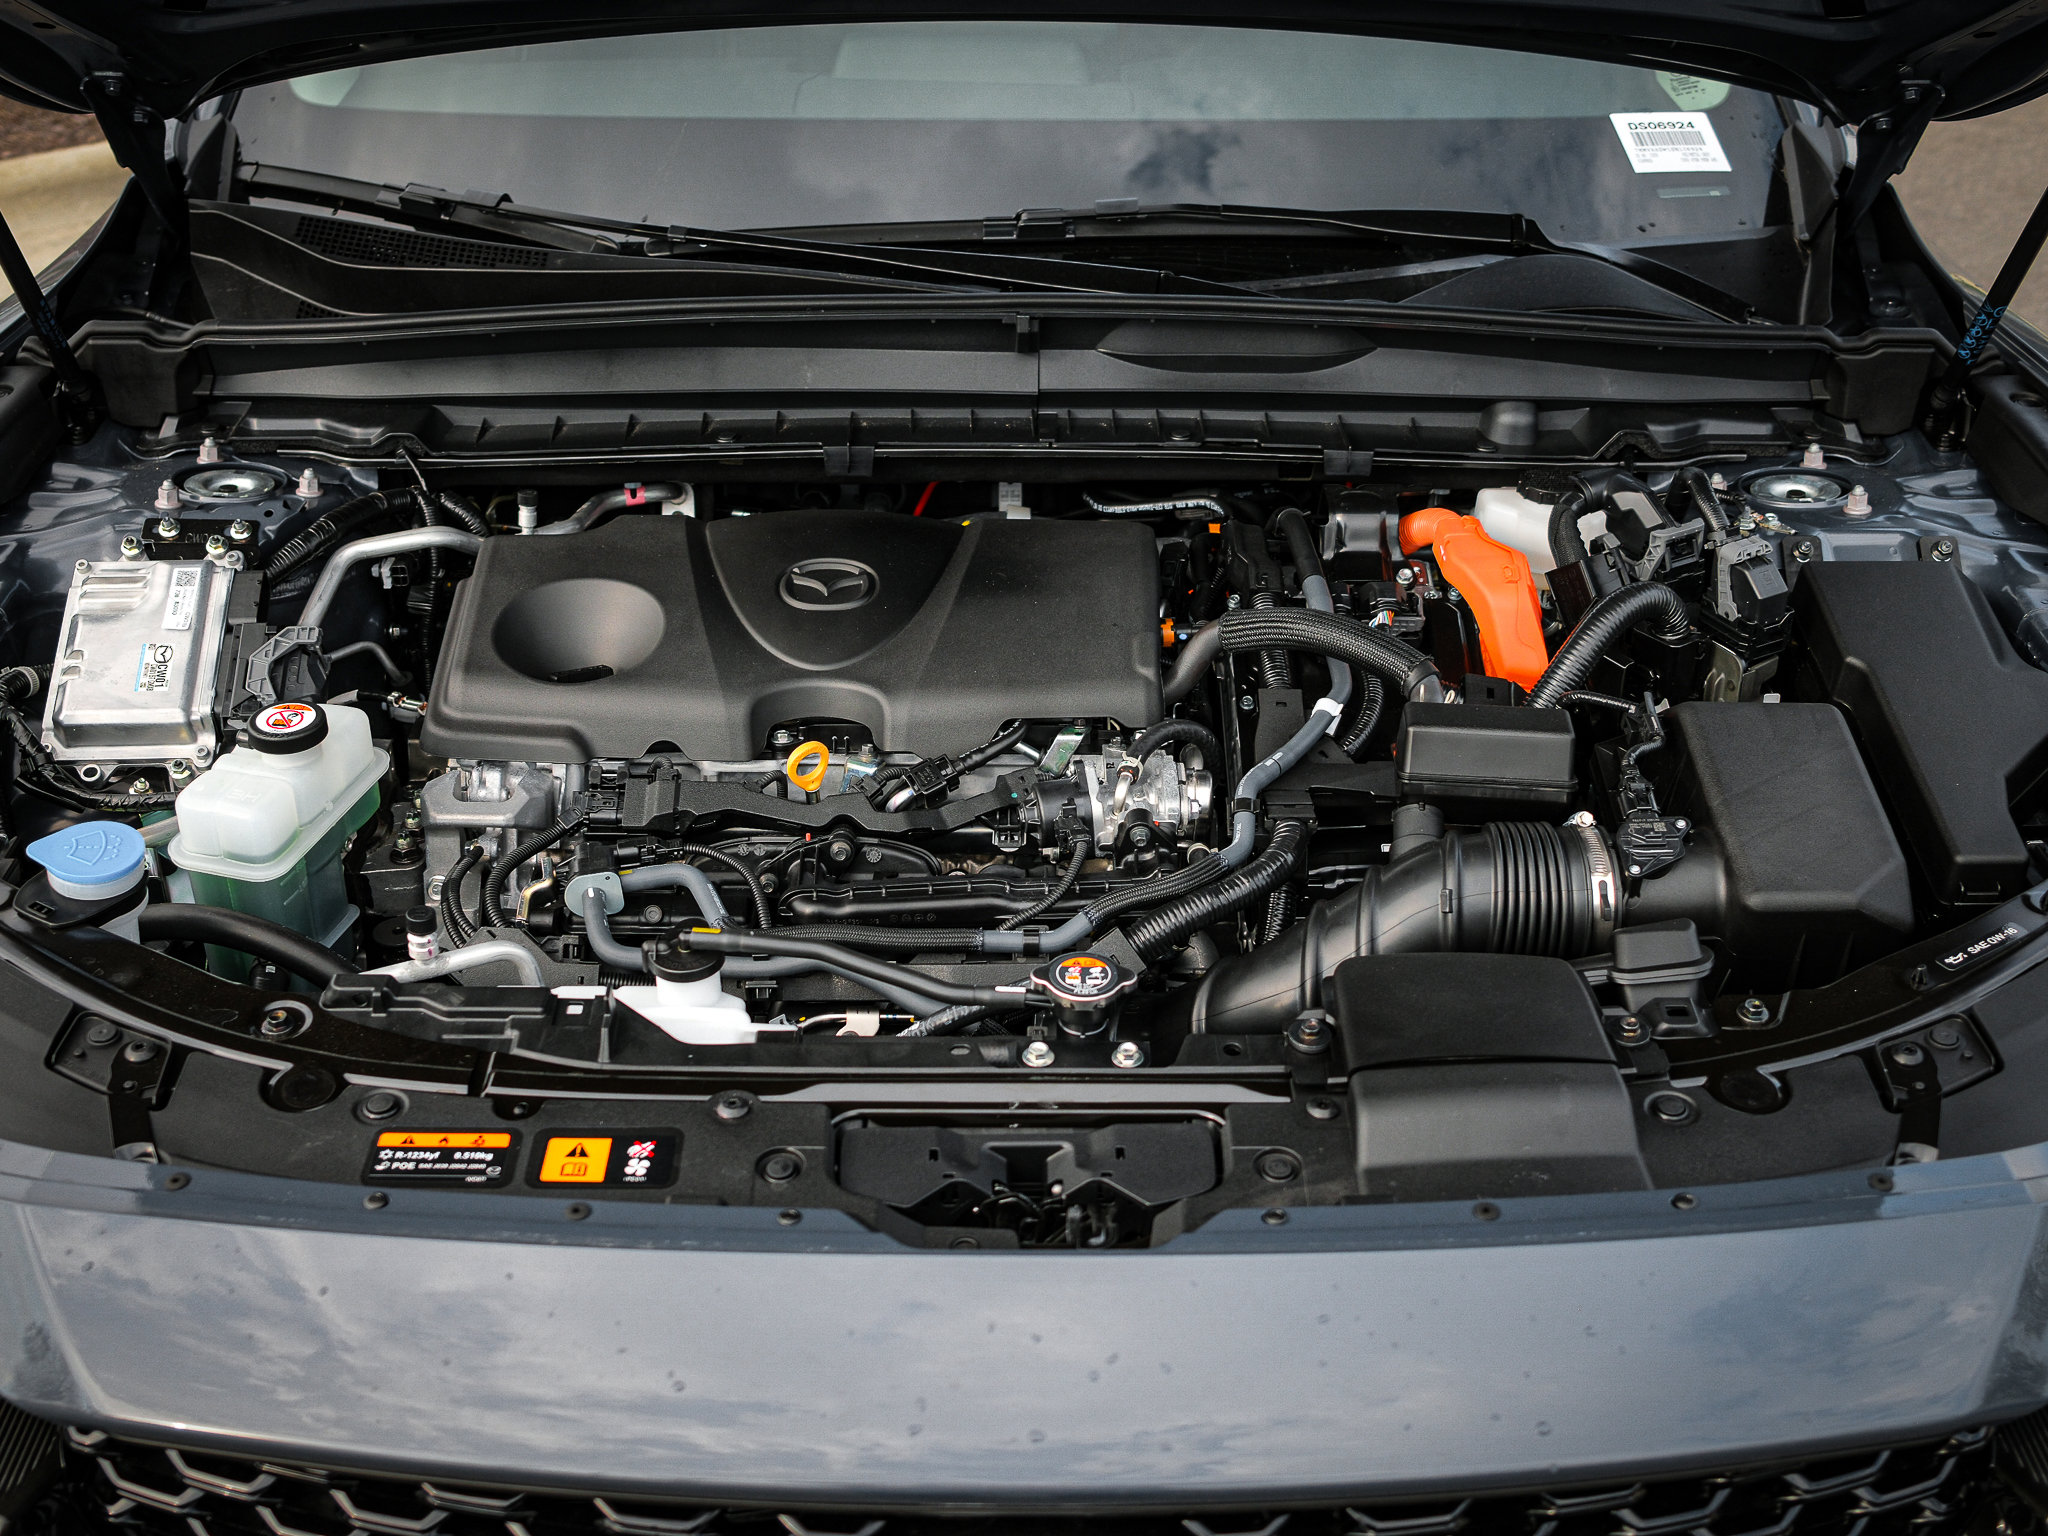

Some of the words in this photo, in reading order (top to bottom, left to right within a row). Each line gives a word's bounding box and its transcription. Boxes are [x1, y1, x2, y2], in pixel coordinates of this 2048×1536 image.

[1628, 121, 1695, 130] DS06924
[155, 664, 168, 688] CW01
[1967, 940, 1991, 954] SAE
[1987, 927, 2018, 944] 0W-16
[394, 1151, 440, 1160] R-1234yf
[391, 1162, 416, 1170] POE
